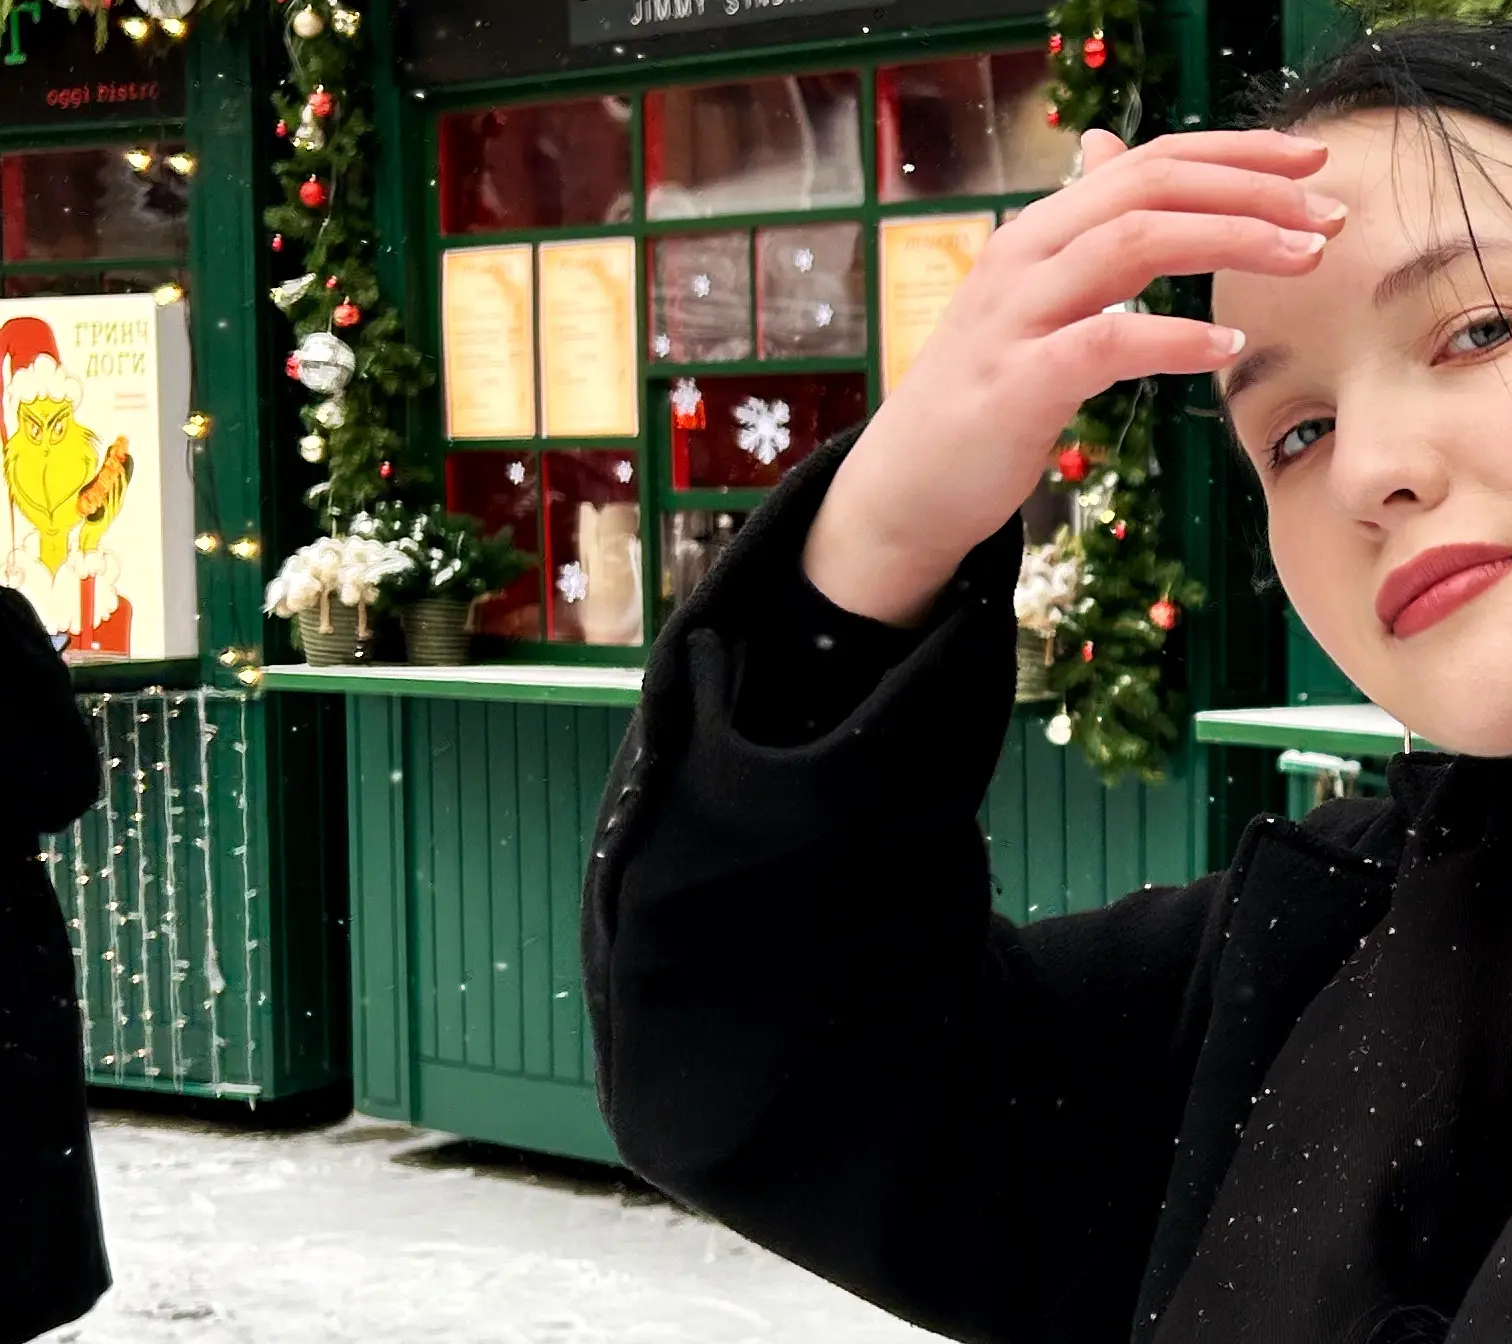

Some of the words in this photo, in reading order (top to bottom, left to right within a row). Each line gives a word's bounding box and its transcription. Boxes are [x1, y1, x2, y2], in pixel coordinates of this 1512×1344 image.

[46, 85, 91, 109] oggi
[97, 81, 162, 103] bistro
[74, 319, 149, 348] ГРИНЧ
[86, 352, 147, 378] ДОГИ
